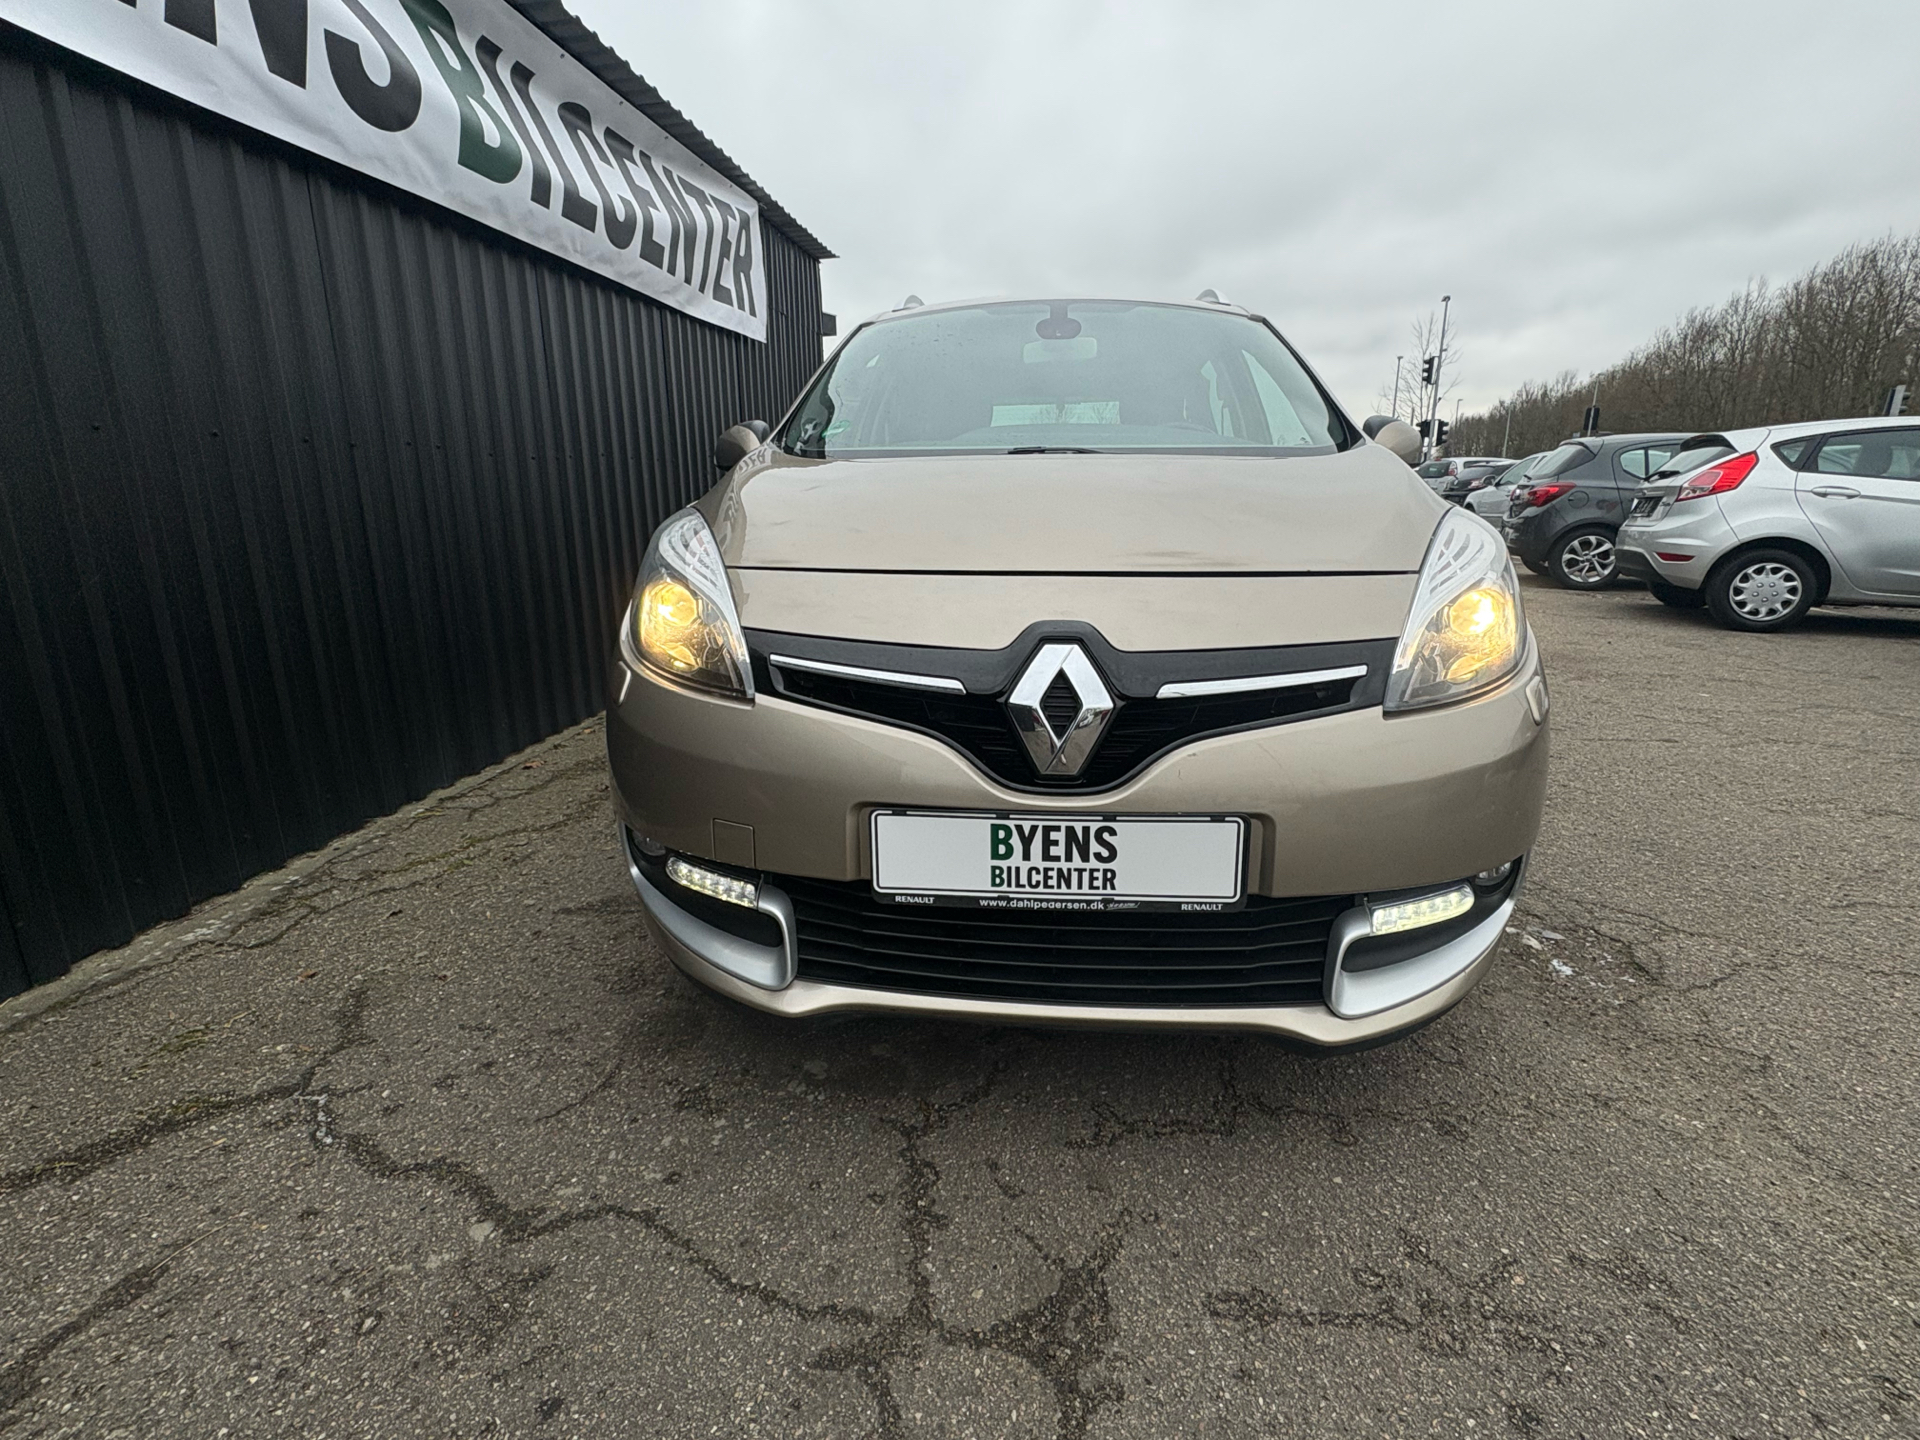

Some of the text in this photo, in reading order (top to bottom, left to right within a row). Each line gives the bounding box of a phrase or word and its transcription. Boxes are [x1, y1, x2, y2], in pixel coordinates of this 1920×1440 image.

[396, 0, 757, 318] BILCENTER
[990, 823, 1118, 864] BYENS
[990, 865, 1117, 891] BILCENTER
[895, 895, 935, 904] RENAULT
[979, 899, 1105, 910] www.dahlpedersen.dk
[1181, 903, 1223, 911] RENAULT
